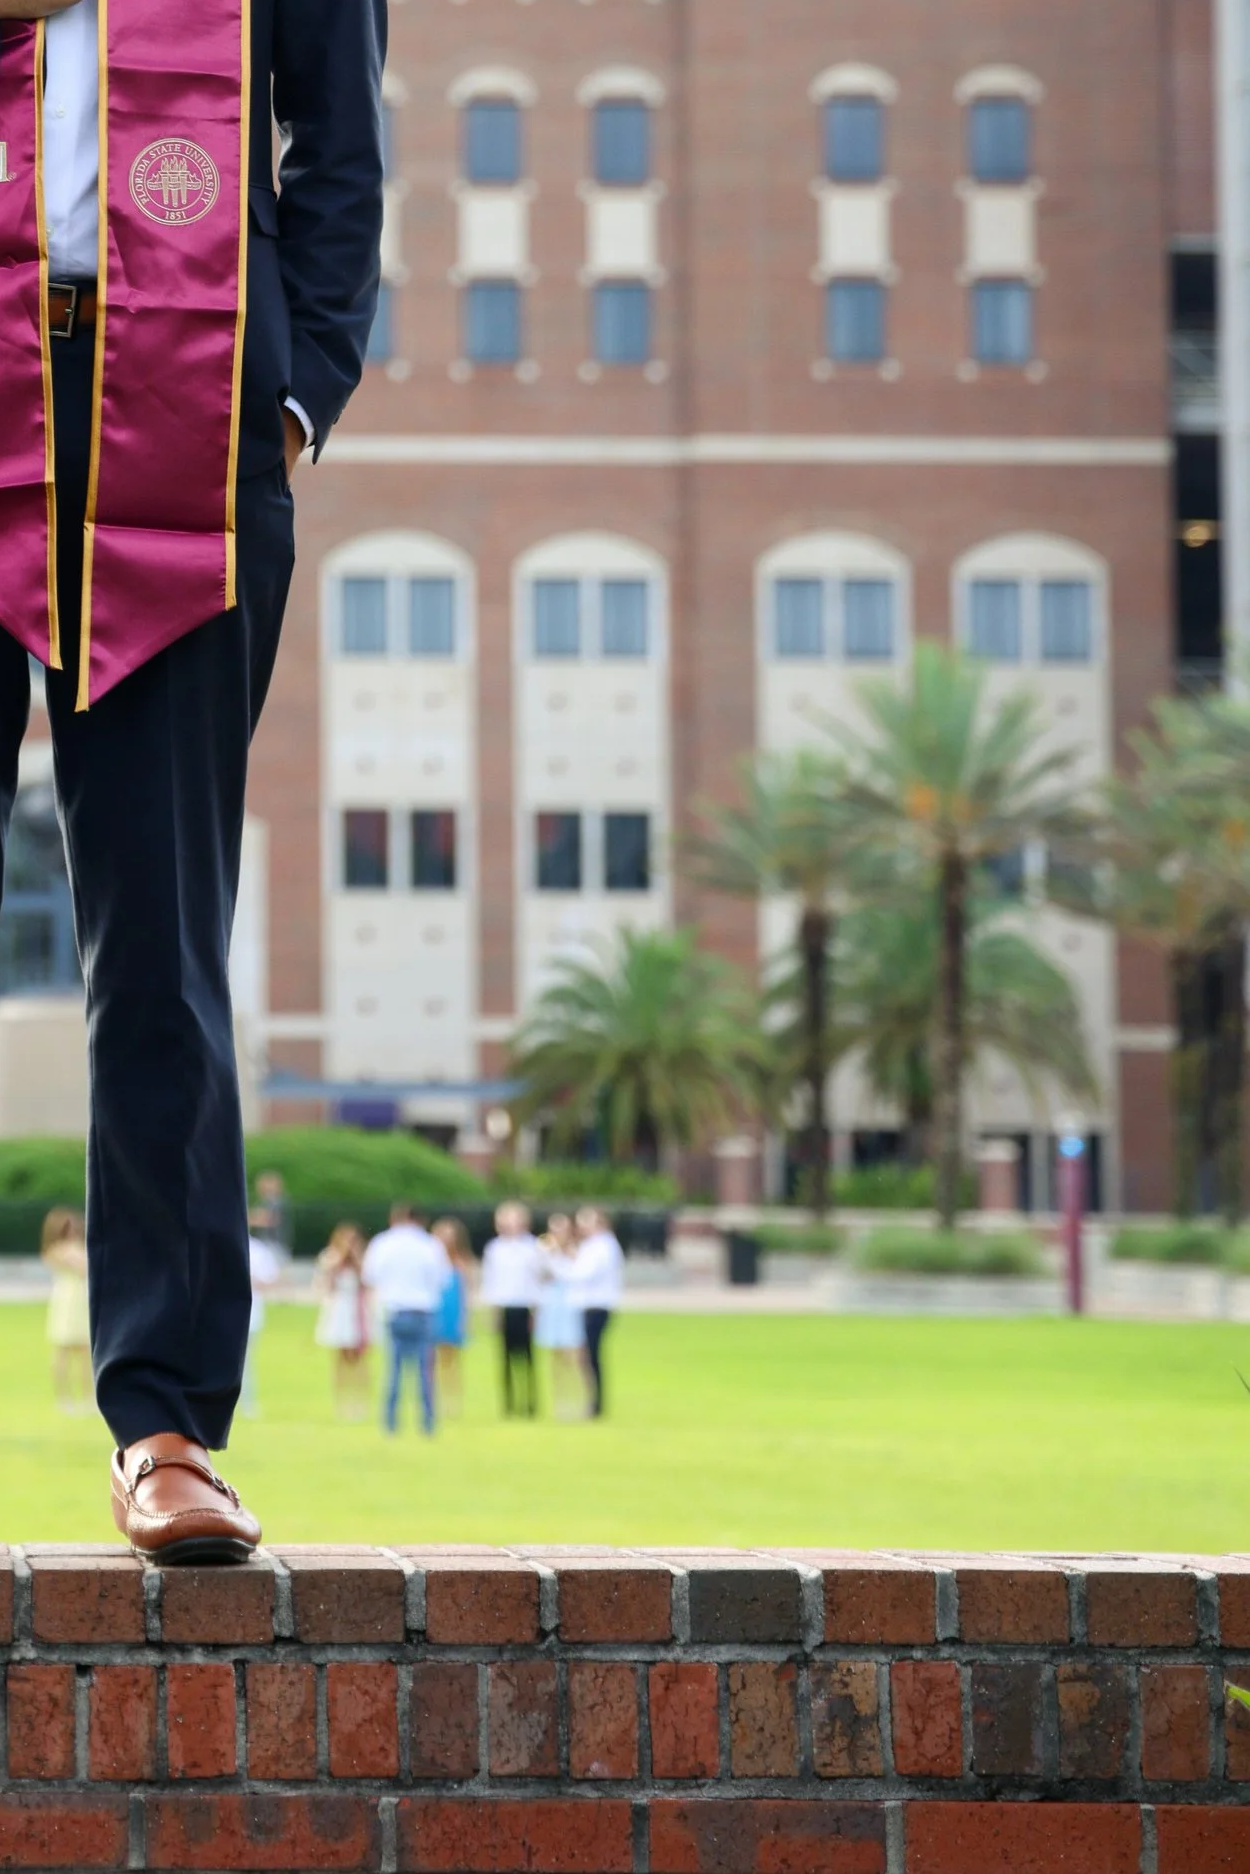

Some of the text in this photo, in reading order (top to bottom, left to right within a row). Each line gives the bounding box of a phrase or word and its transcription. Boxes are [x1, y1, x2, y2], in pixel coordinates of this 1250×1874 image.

[135, 144, 214, 205] FLORIDA STATE UNIVERSITY
[164, 210, 187, 220] 1851
